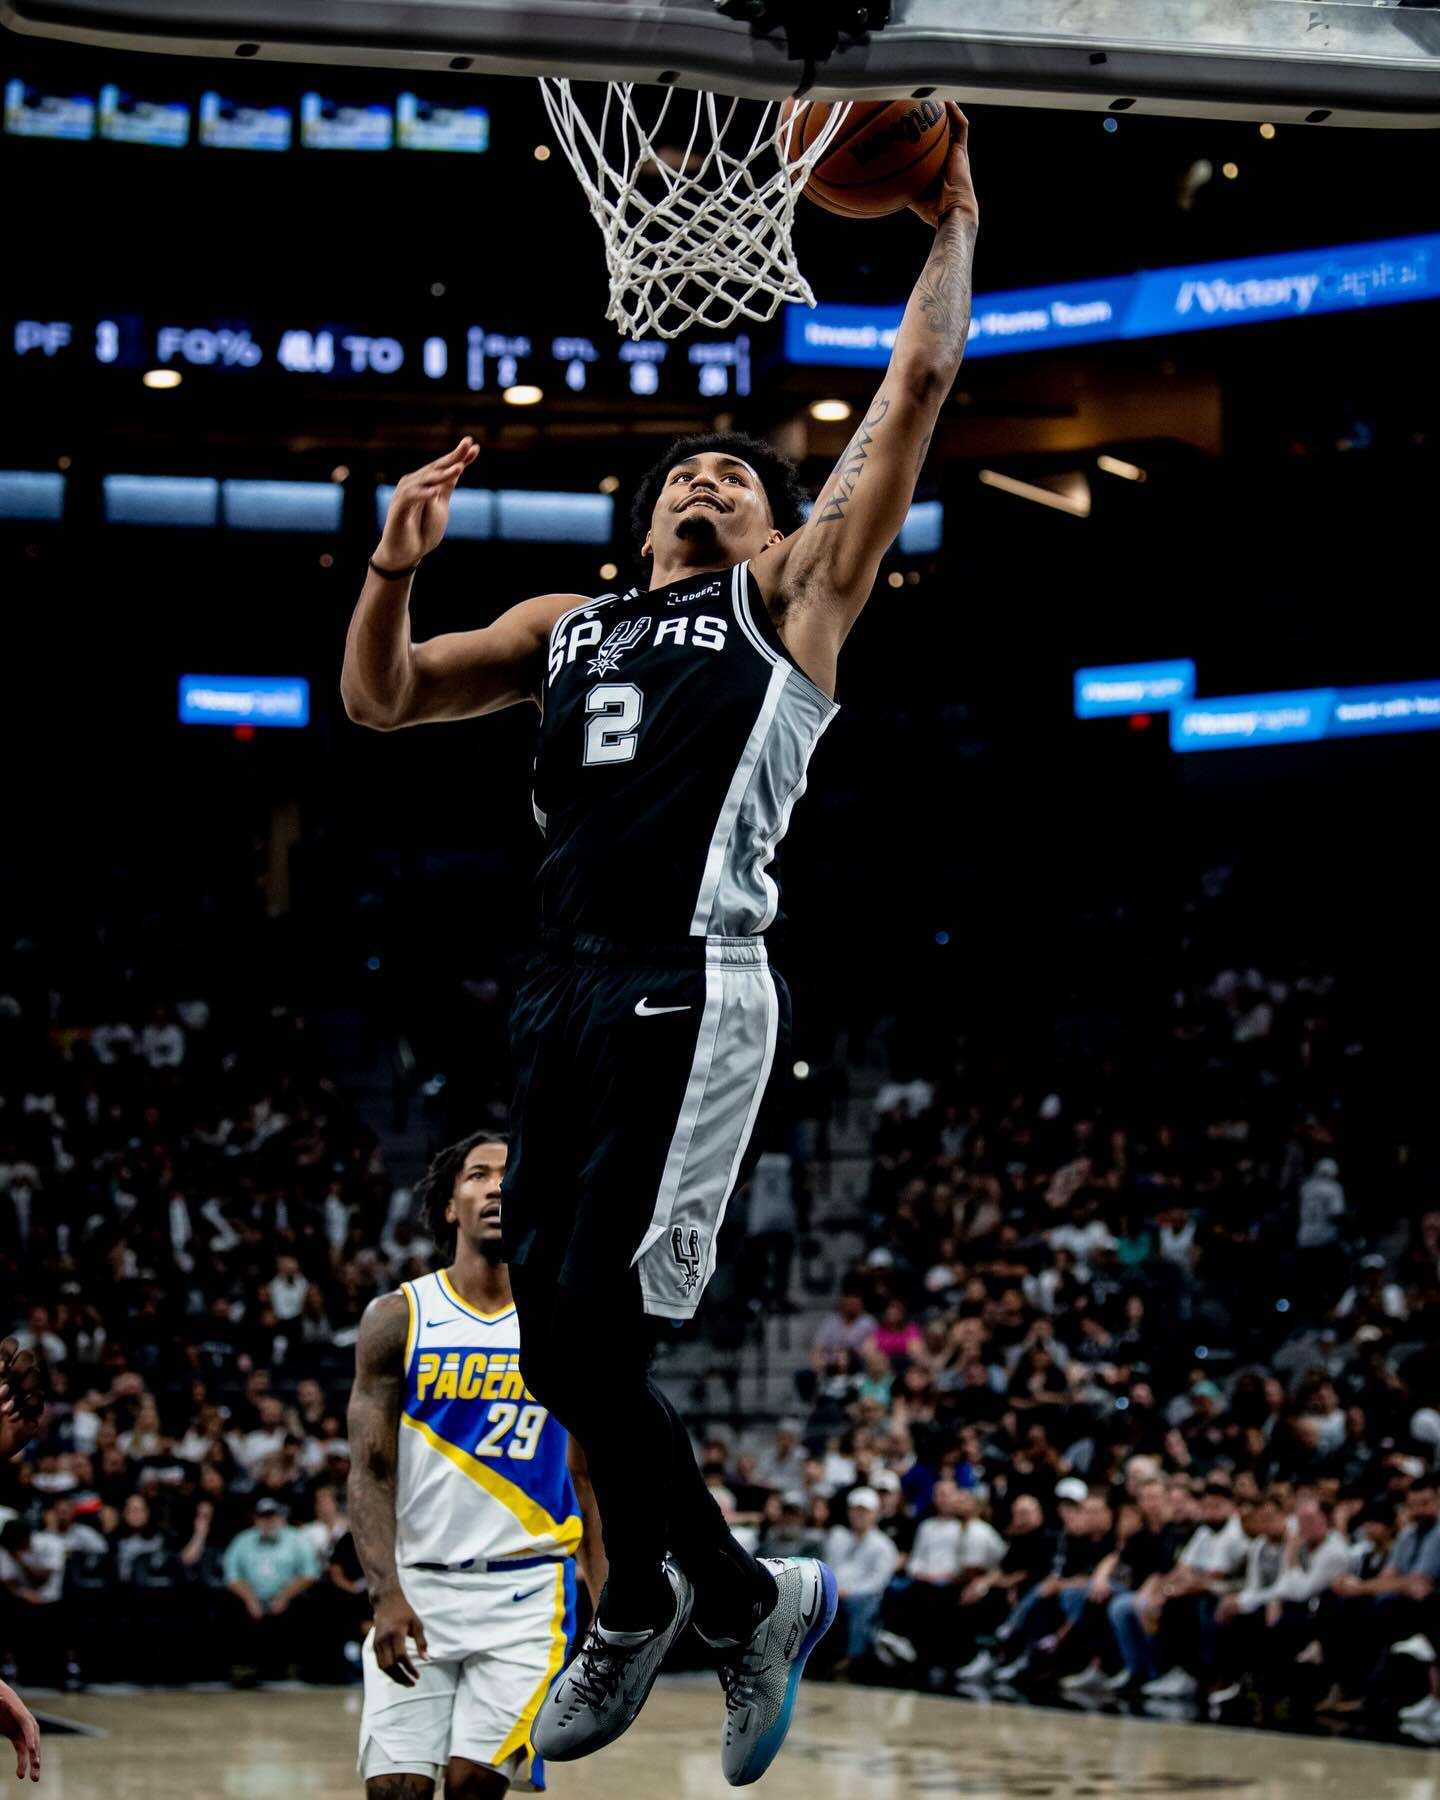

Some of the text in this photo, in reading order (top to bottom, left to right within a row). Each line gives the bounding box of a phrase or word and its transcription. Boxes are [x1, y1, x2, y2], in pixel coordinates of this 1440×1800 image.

[341, 335, 404, 374] TO
[675, 586, 714, 603] LEDGER
[582, 683, 644, 766] 2
[416, 1352, 538, 1402] PACER
[474, 1402, 550, 1461] 29
